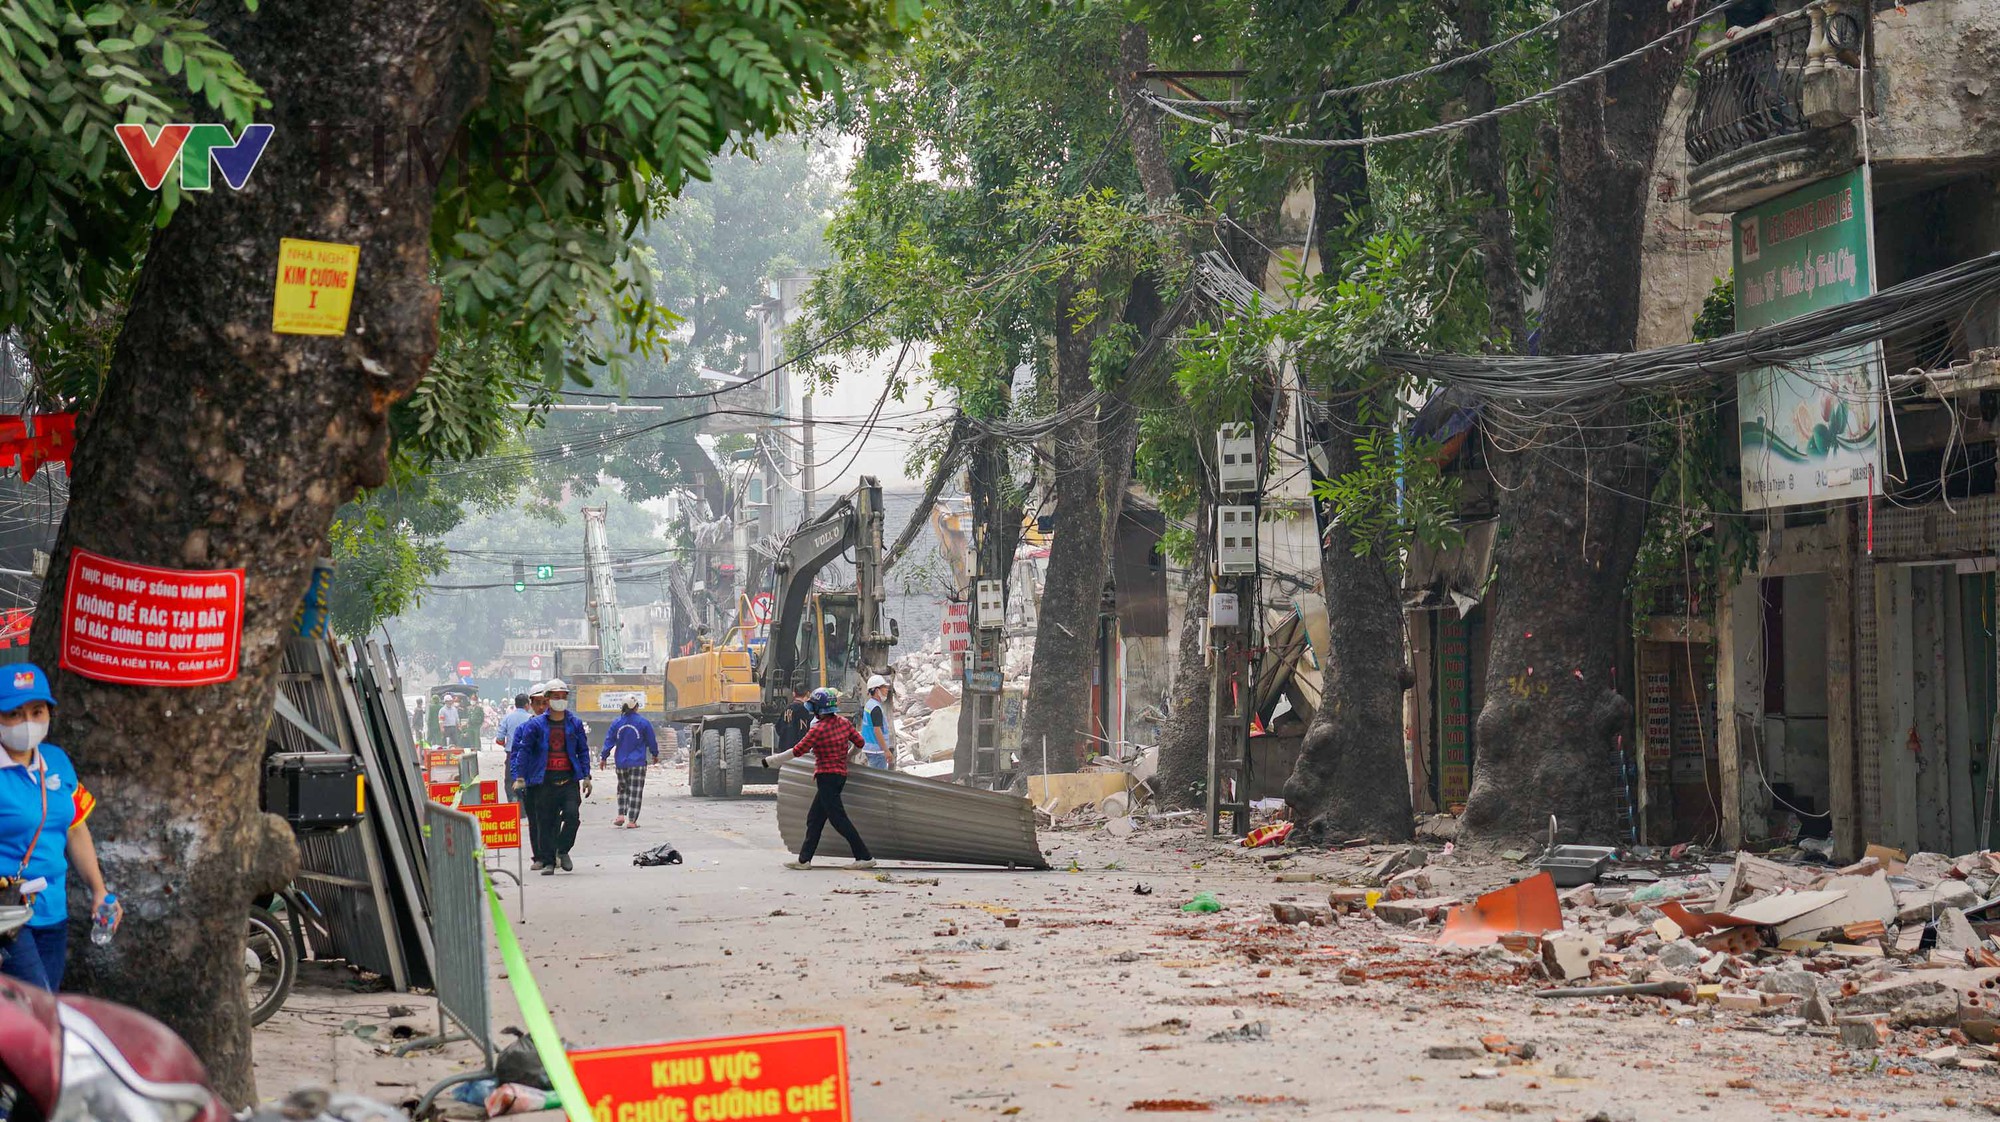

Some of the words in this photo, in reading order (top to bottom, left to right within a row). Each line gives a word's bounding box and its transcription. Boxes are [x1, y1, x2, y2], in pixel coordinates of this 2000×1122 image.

[284, 265, 307, 286] KIM
[814, 526, 840, 548] VOLVO
[82, 566, 101, 585] THỰC
[102, 573, 124, 590] HIỆN
[126, 577, 147, 594] NẾP
[149, 580, 178, 598] SỐNG
[538, 567, 551, 579] 27
[76, 593, 115, 619] KHÔNG
[117, 600, 138, 623] ĐỂ
[139, 605, 168, 627] RÁC
[172, 611, 195, 632] TẠI
[198, 607, 227, 628] ĐÂY
[74, 614, 89, 635] ĐỔ
[88, 620, 109, 640] RÁC
[111, 625, 143, 646] ĐÚNG
[146, 629, 167, 648] GIỜ
[169, 633, 194, 650] QUY
[196, 632, 225, 651] ĐỊNH
[82, 649, 120, 665] CAMERA
[149, 659, 170, 670] TRA
[178, 659, 204, 671] GIÁM
[206, 657, 226, 669] SÁT
[499, 818, 516, 831] CHẾ
[504, 832, 518, 843] VÀO
[652, 1057, 705, 1089] KHU
[709, 1050, 762, 1086] VỰC
[617, 1094, 690, 1122] CHỨC
[693, 1084, 781, 1122] CƯỜNG
[785, 1074, 838, 1113] CHẾ
